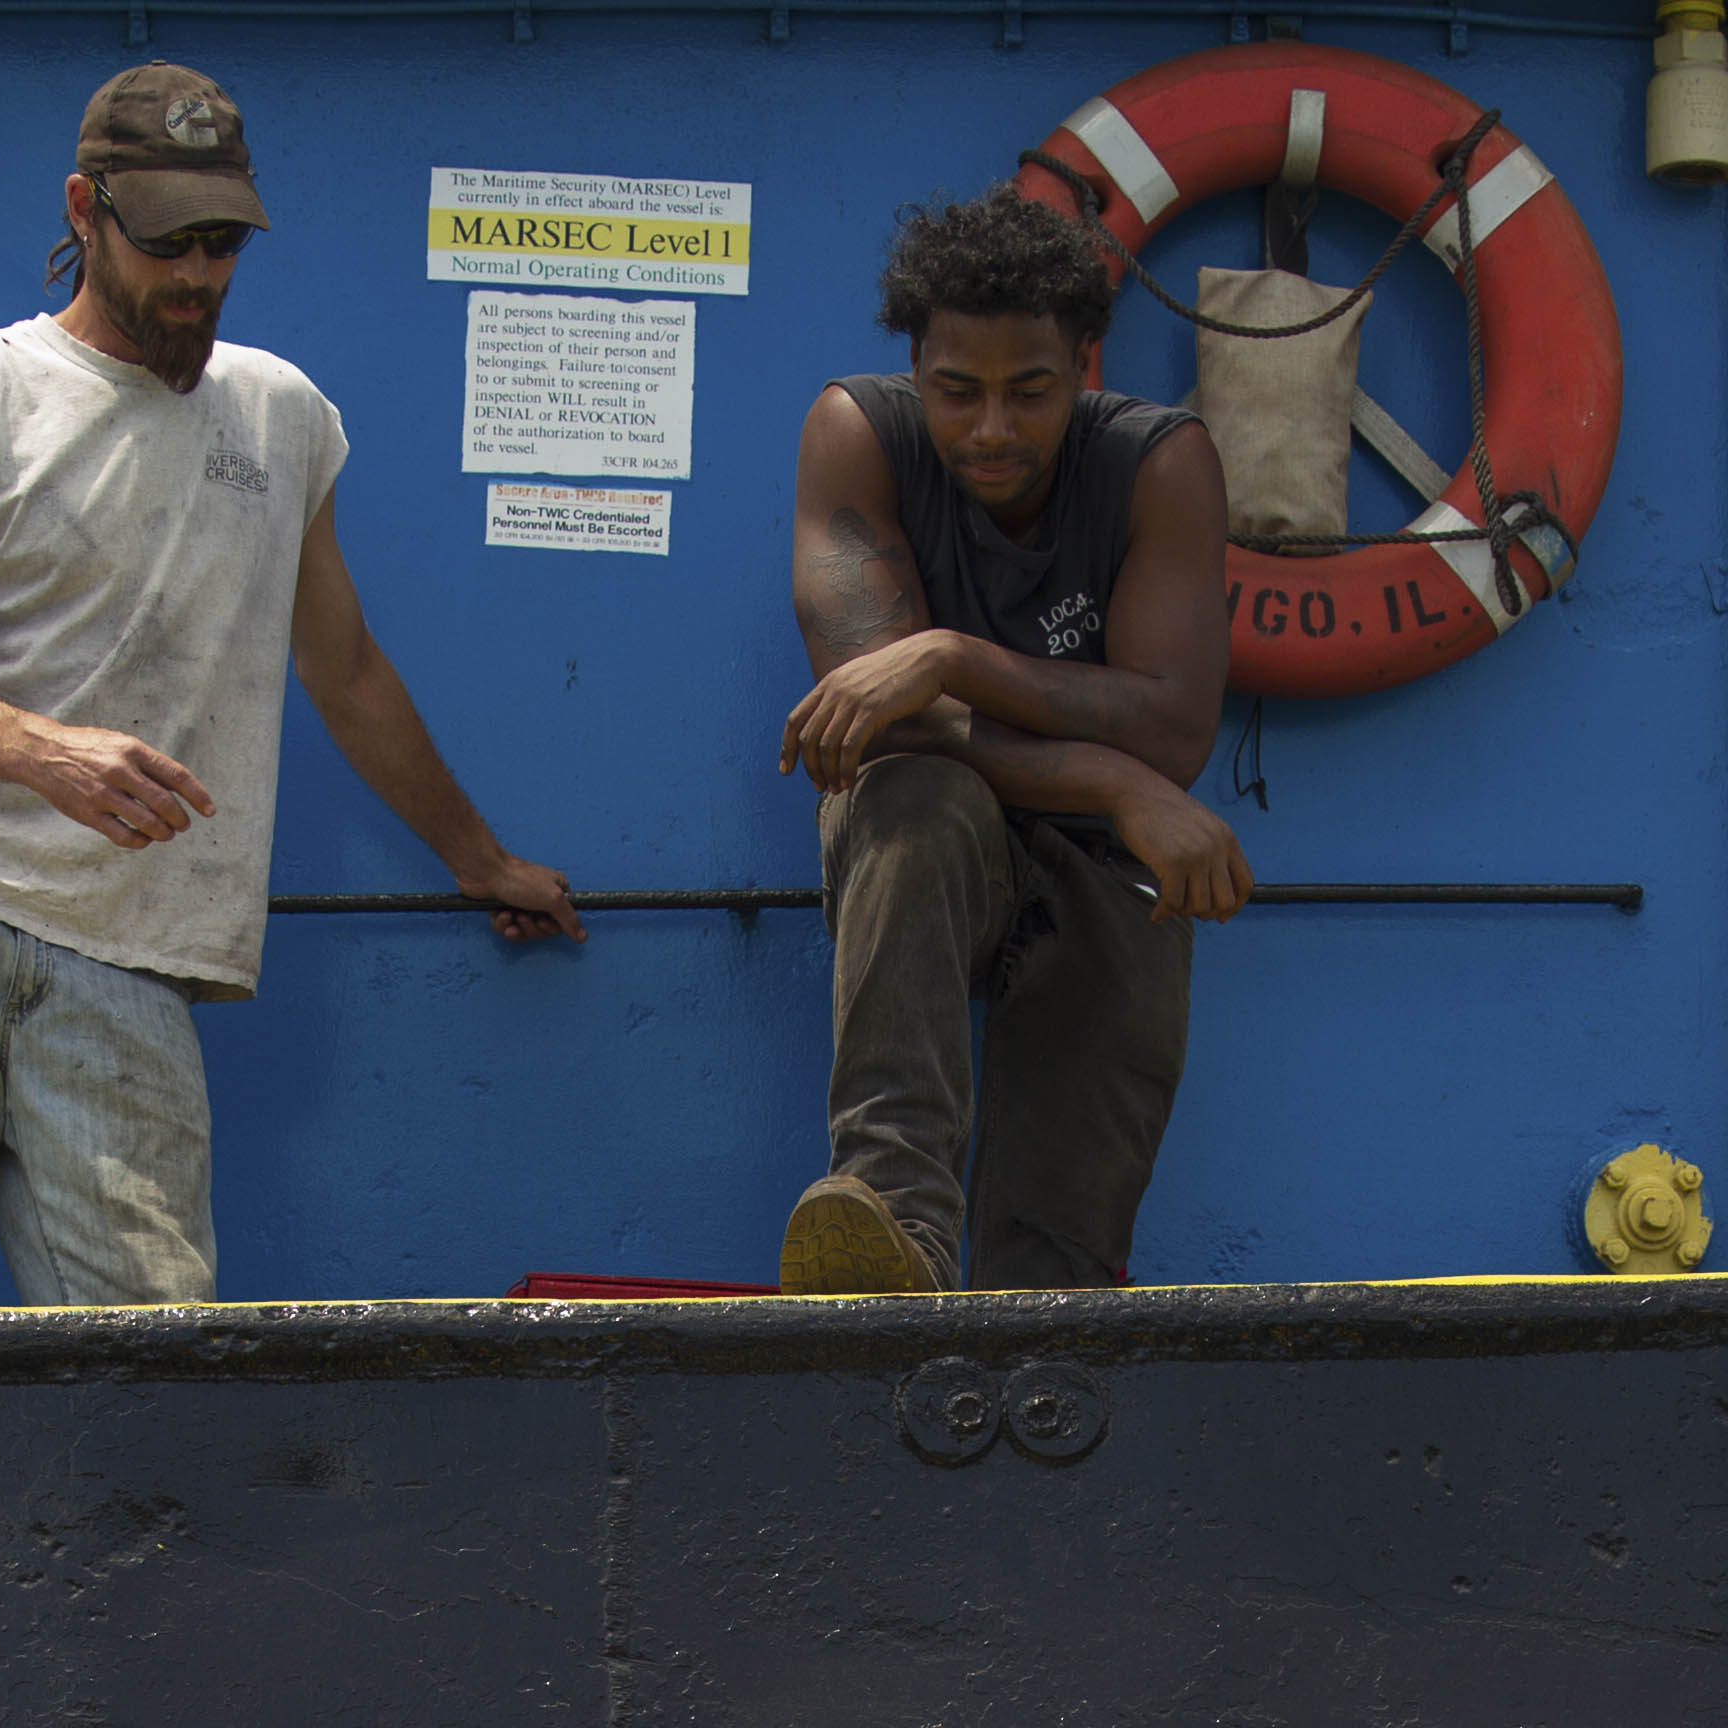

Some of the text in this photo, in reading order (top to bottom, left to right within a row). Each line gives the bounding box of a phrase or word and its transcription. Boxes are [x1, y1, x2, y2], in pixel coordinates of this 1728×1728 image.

[450, 172, 731, 200] The Maritime Security (MARSEC) Level
[458, 191, 520, 207] currently
[526, 193, 540, 206] in
[545, 193, 583, 208] effect
[588, 197, 634, 212] aboard
[640, 200, 661, 212] the
[666, 202, 704, 215] vessel
[451, 215, 613, 251] MARSEC
[626, 224, 712, 257] Level
[452, 256, 725, 286] Normal Operating Conditions
[479, 304, 686, 326] All persons boarding this vessel
[477, 322, 680, 343] are subject to screening and/or
[476, 337, 676, 360] inspection of their person and
[559, 358, 605, 373] Failure
[475, 373, 660, 394] to or submit to screening or
[475, 388, 646, 409] inspection WILL result in
[474, 405, 656, 426] DENIAL or REVOCATION
[473, 423, 665, 444] of the authorization to board
[473, 439, 538, 455] the vessel.
[506, 504, 650, 525] Non-TWIC Credentialed
[492, 516, 663, 538] Personnel Must Be Escorted
[1038, 592, 1096, 633] LOCA
[1048, 612, 1100, 656] 200
